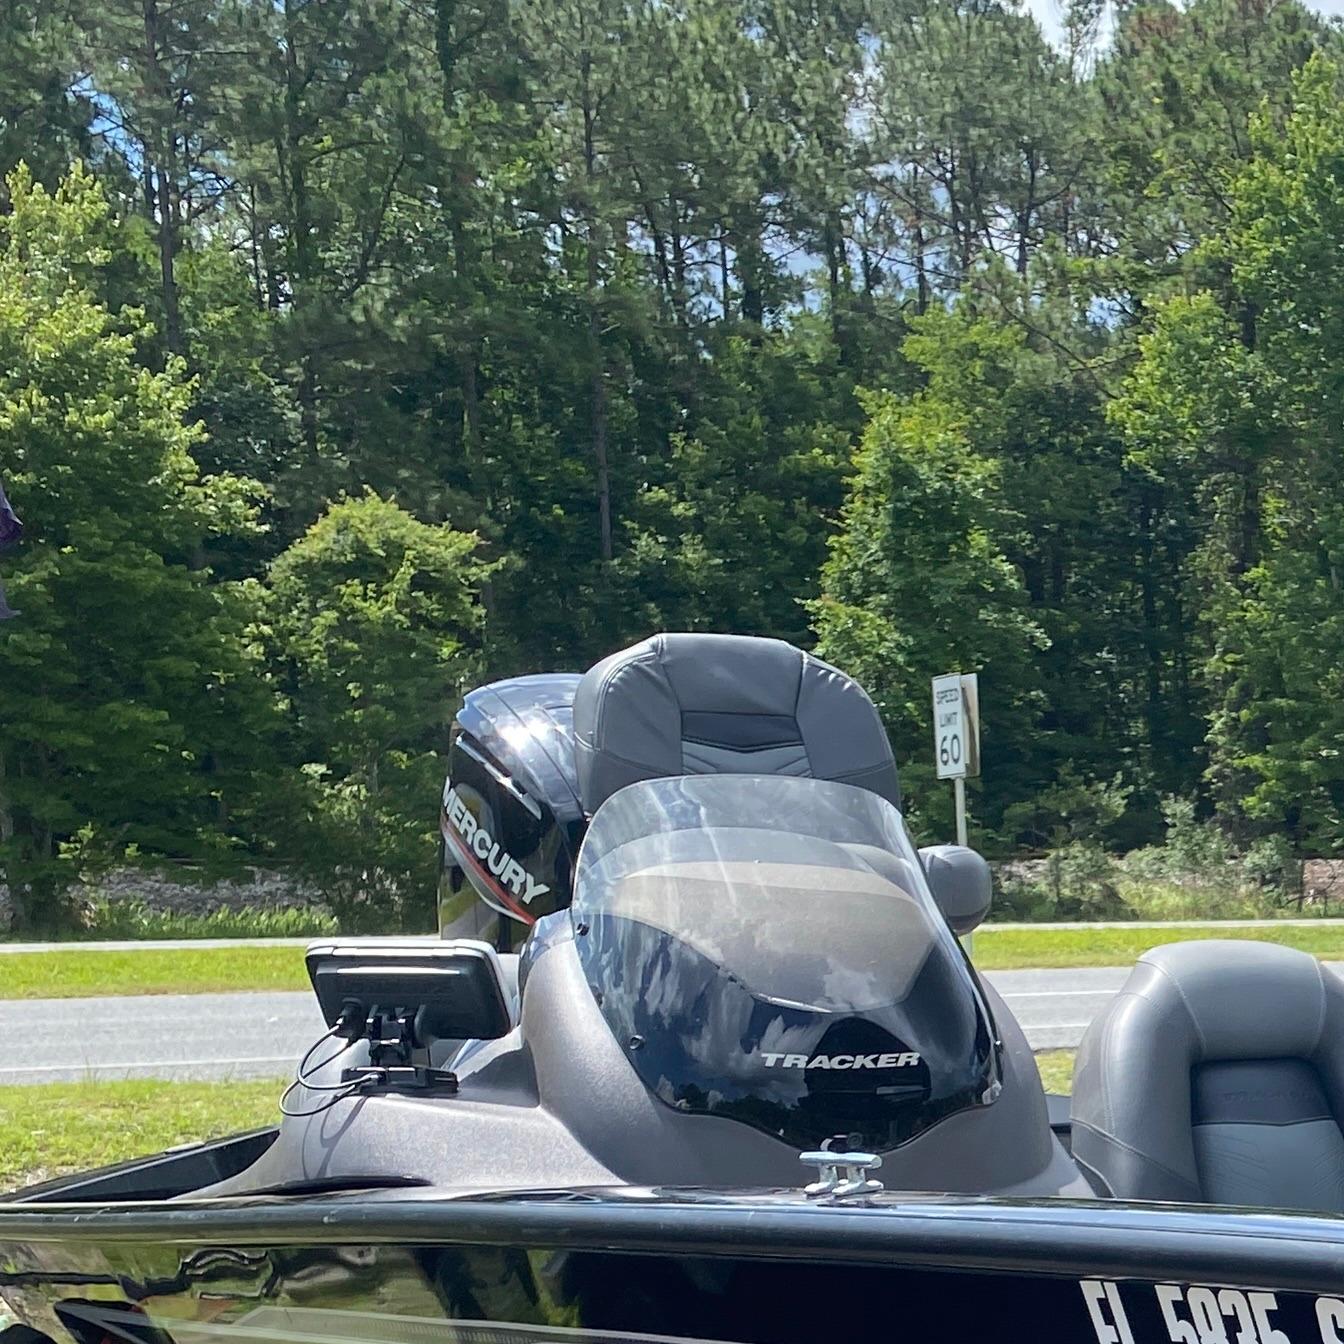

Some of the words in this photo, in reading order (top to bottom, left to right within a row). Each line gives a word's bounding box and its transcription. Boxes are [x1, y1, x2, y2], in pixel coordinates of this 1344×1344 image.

[940, 733, 961, 767] 60
[442, 775, 551, 905] MERCURY
[760, 1051, 921, 1070] TRACKER
